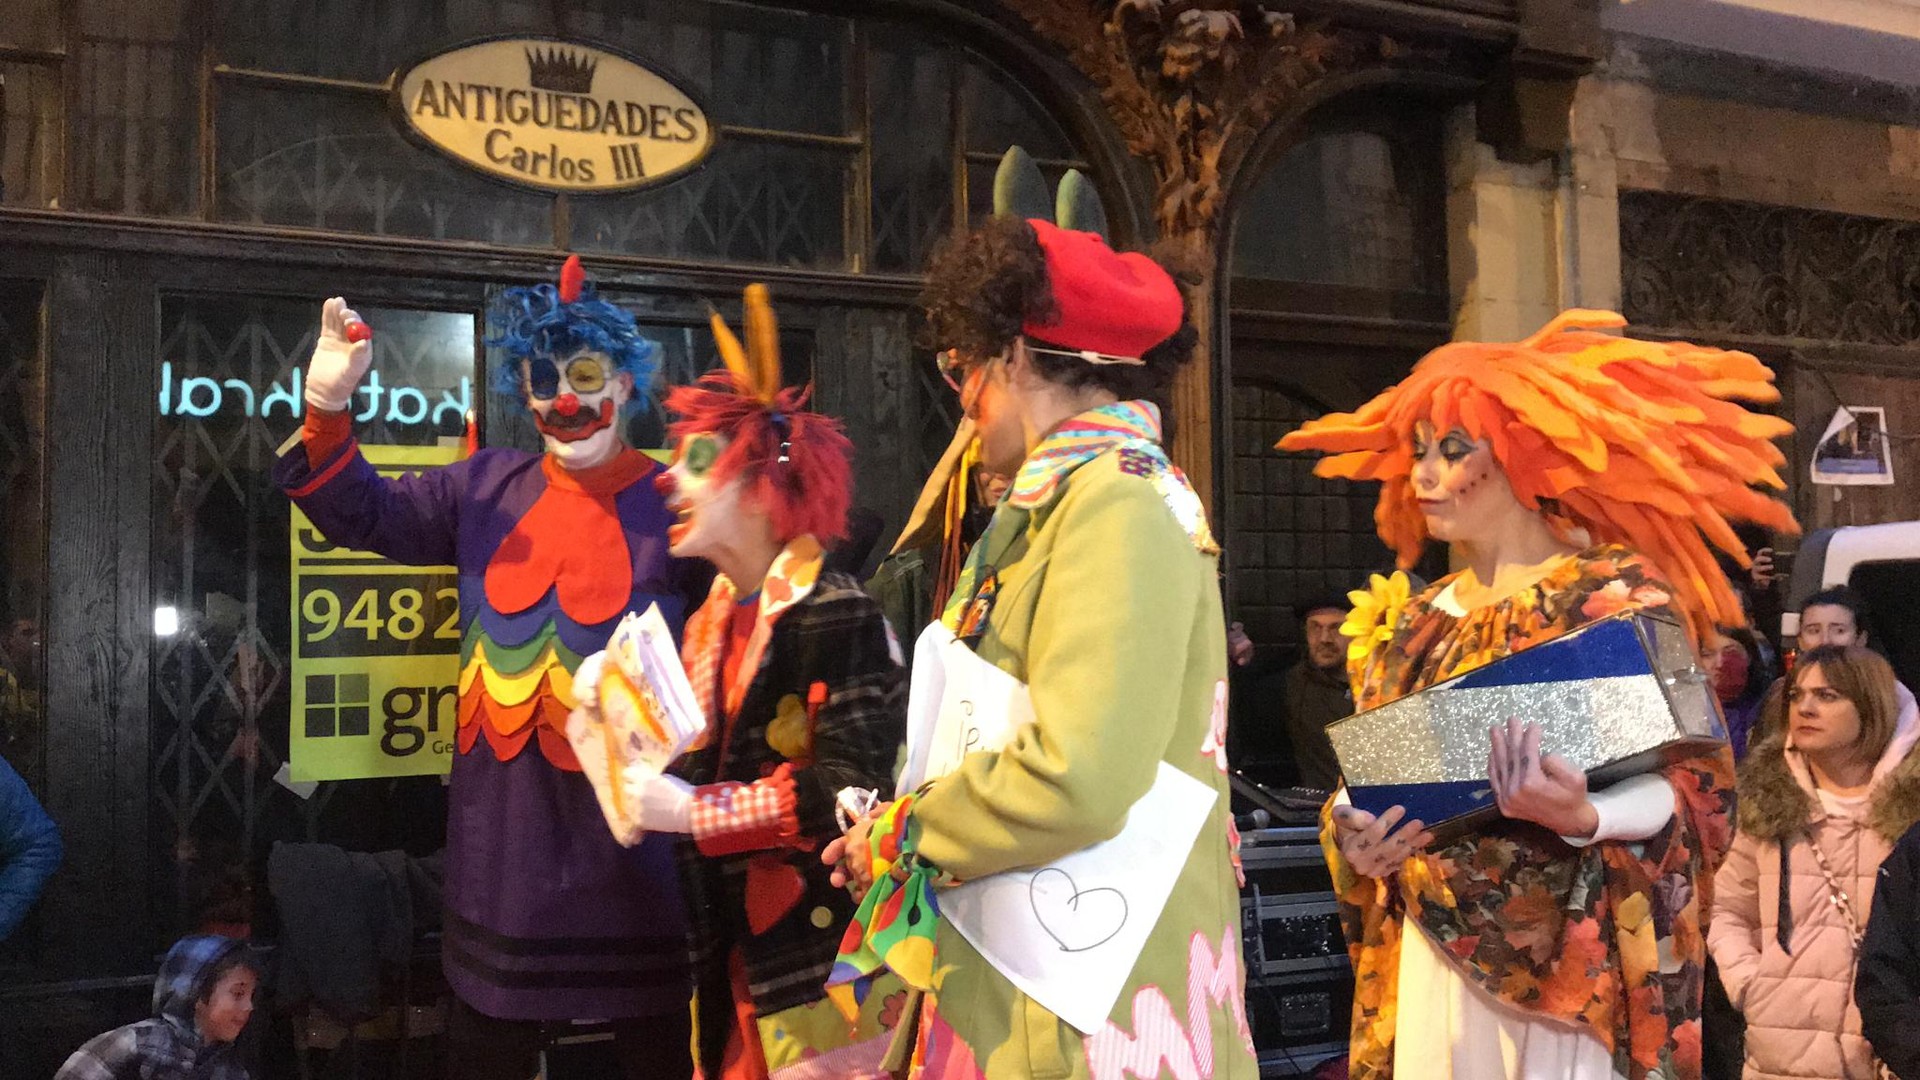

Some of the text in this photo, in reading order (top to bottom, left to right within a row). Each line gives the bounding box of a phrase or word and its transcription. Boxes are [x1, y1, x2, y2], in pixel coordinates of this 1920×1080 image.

[415, 78, 698, 142] ANTIGUEDADES
[484, 128, 645, 182] Carlos III
